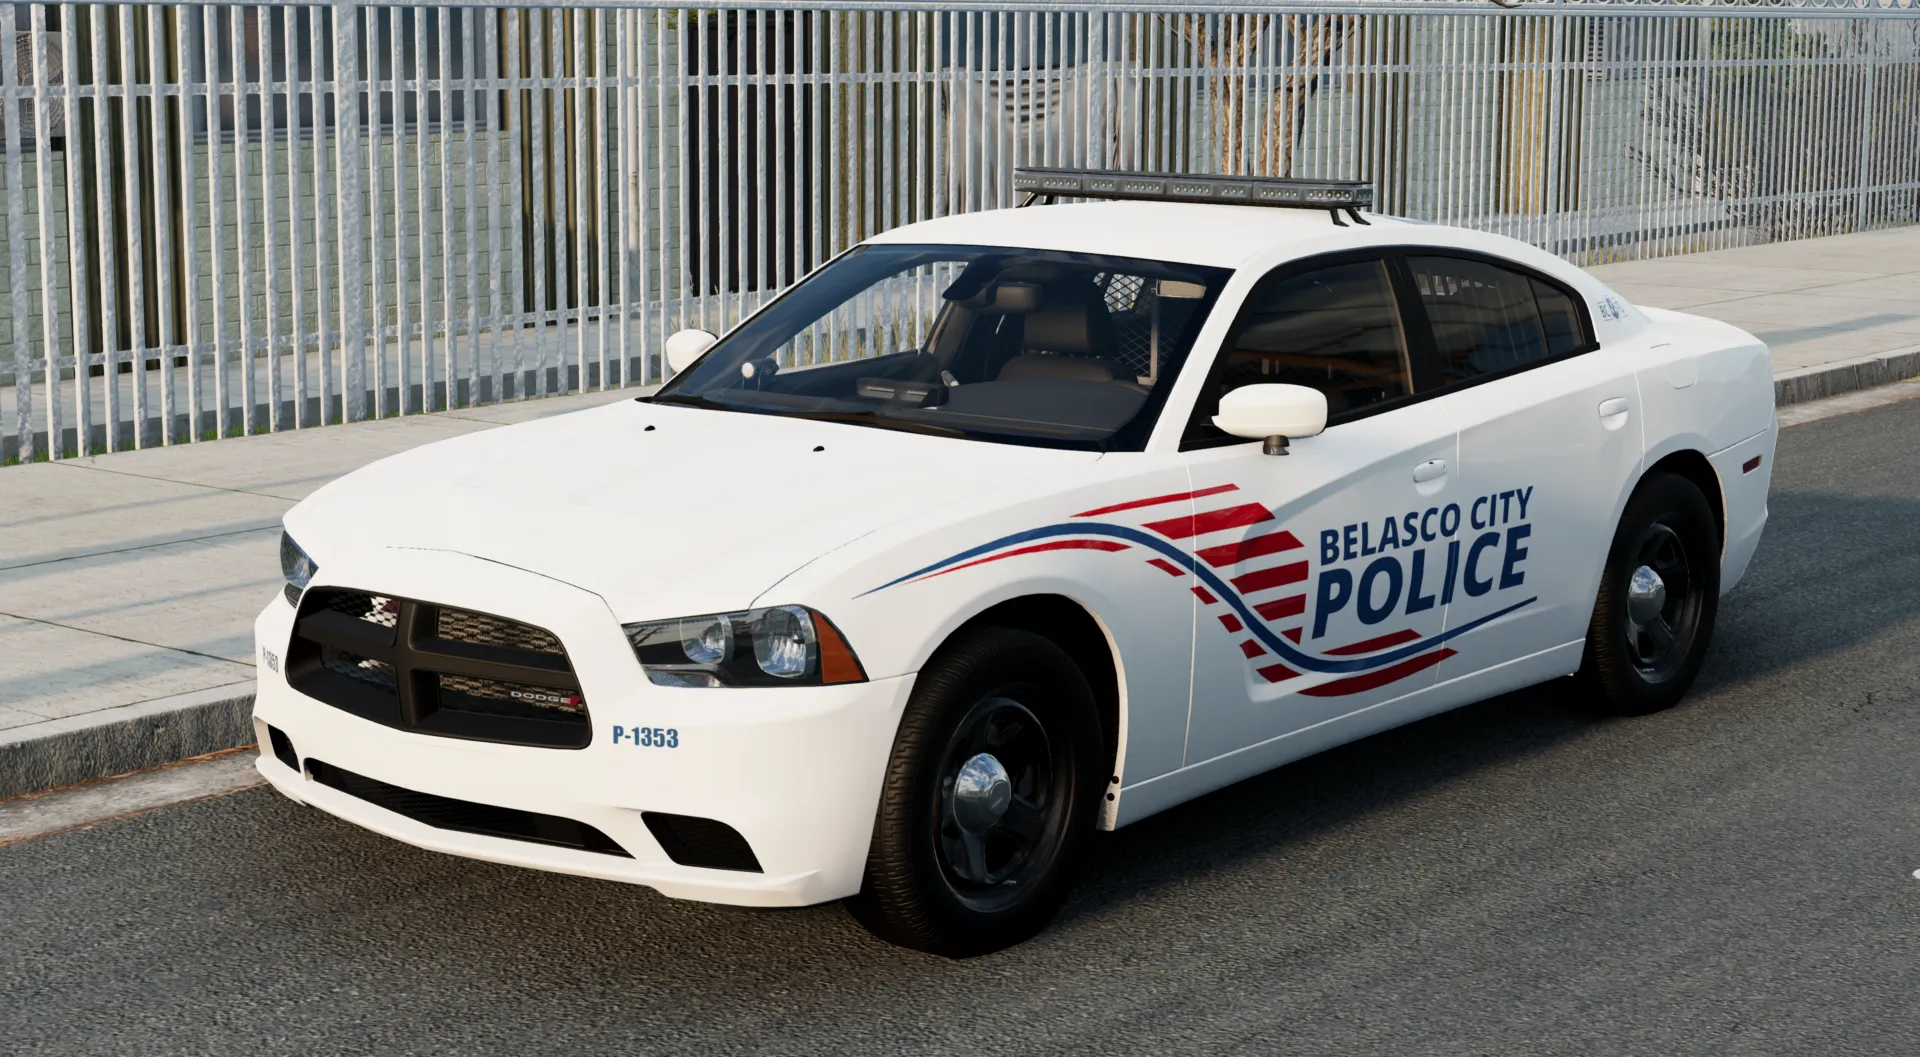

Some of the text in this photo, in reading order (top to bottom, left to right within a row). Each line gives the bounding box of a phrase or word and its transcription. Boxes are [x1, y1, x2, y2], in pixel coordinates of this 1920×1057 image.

[1320, 485, 1534, 566] BELASCO CITY
[1311, 523, 1532, 640] POLICE
[510, 691, 571, 704] DODGE
[612, 725, 679, 749] P-1353
